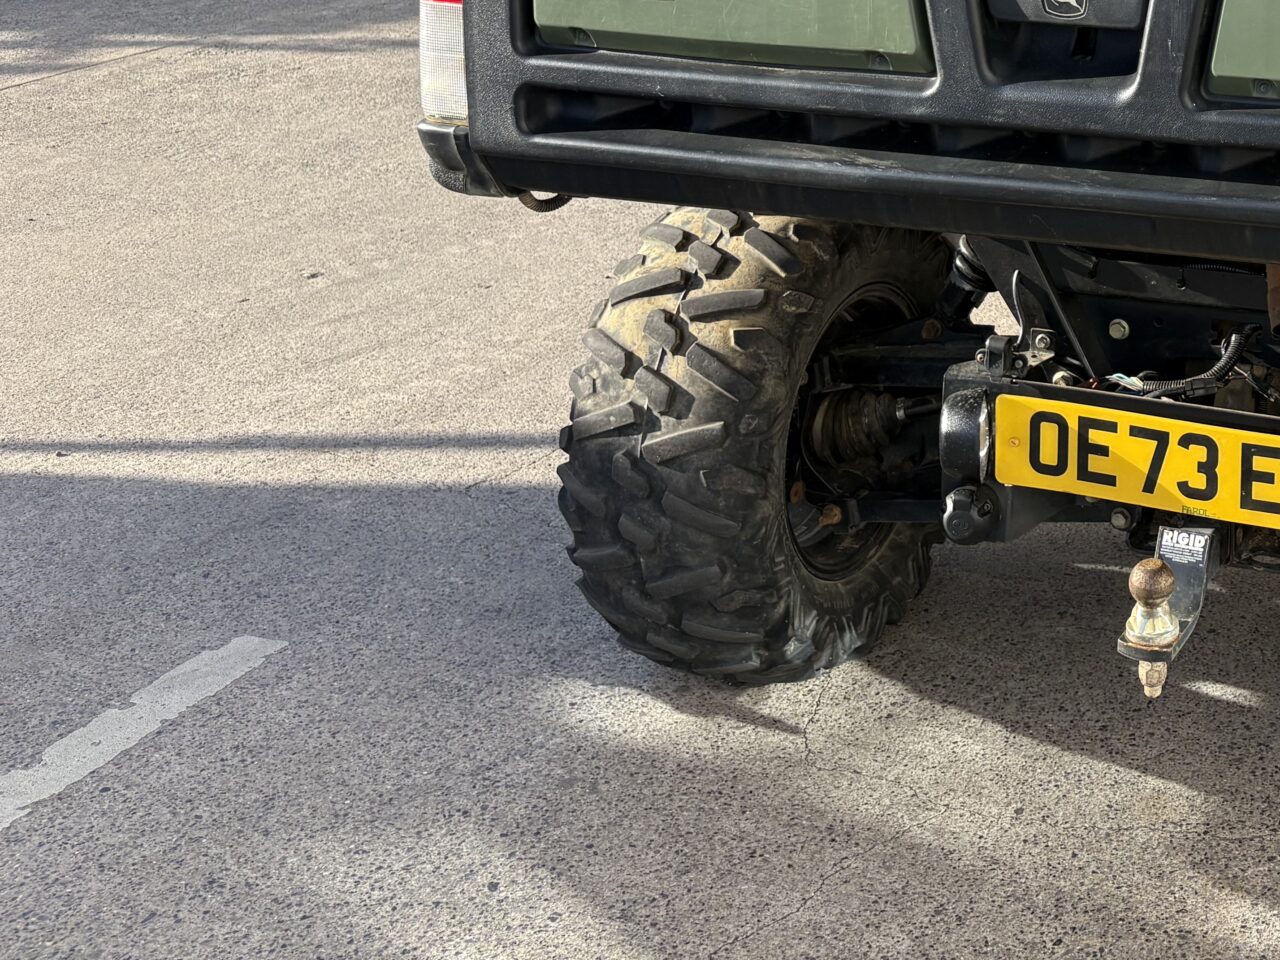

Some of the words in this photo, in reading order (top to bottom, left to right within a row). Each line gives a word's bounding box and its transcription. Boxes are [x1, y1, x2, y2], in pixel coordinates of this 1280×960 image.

[1028, 410, 1219, 502] OE73
[1182, 505, 1209, 517] FAROL
[1162, 529, 1206, 548] RIGID
